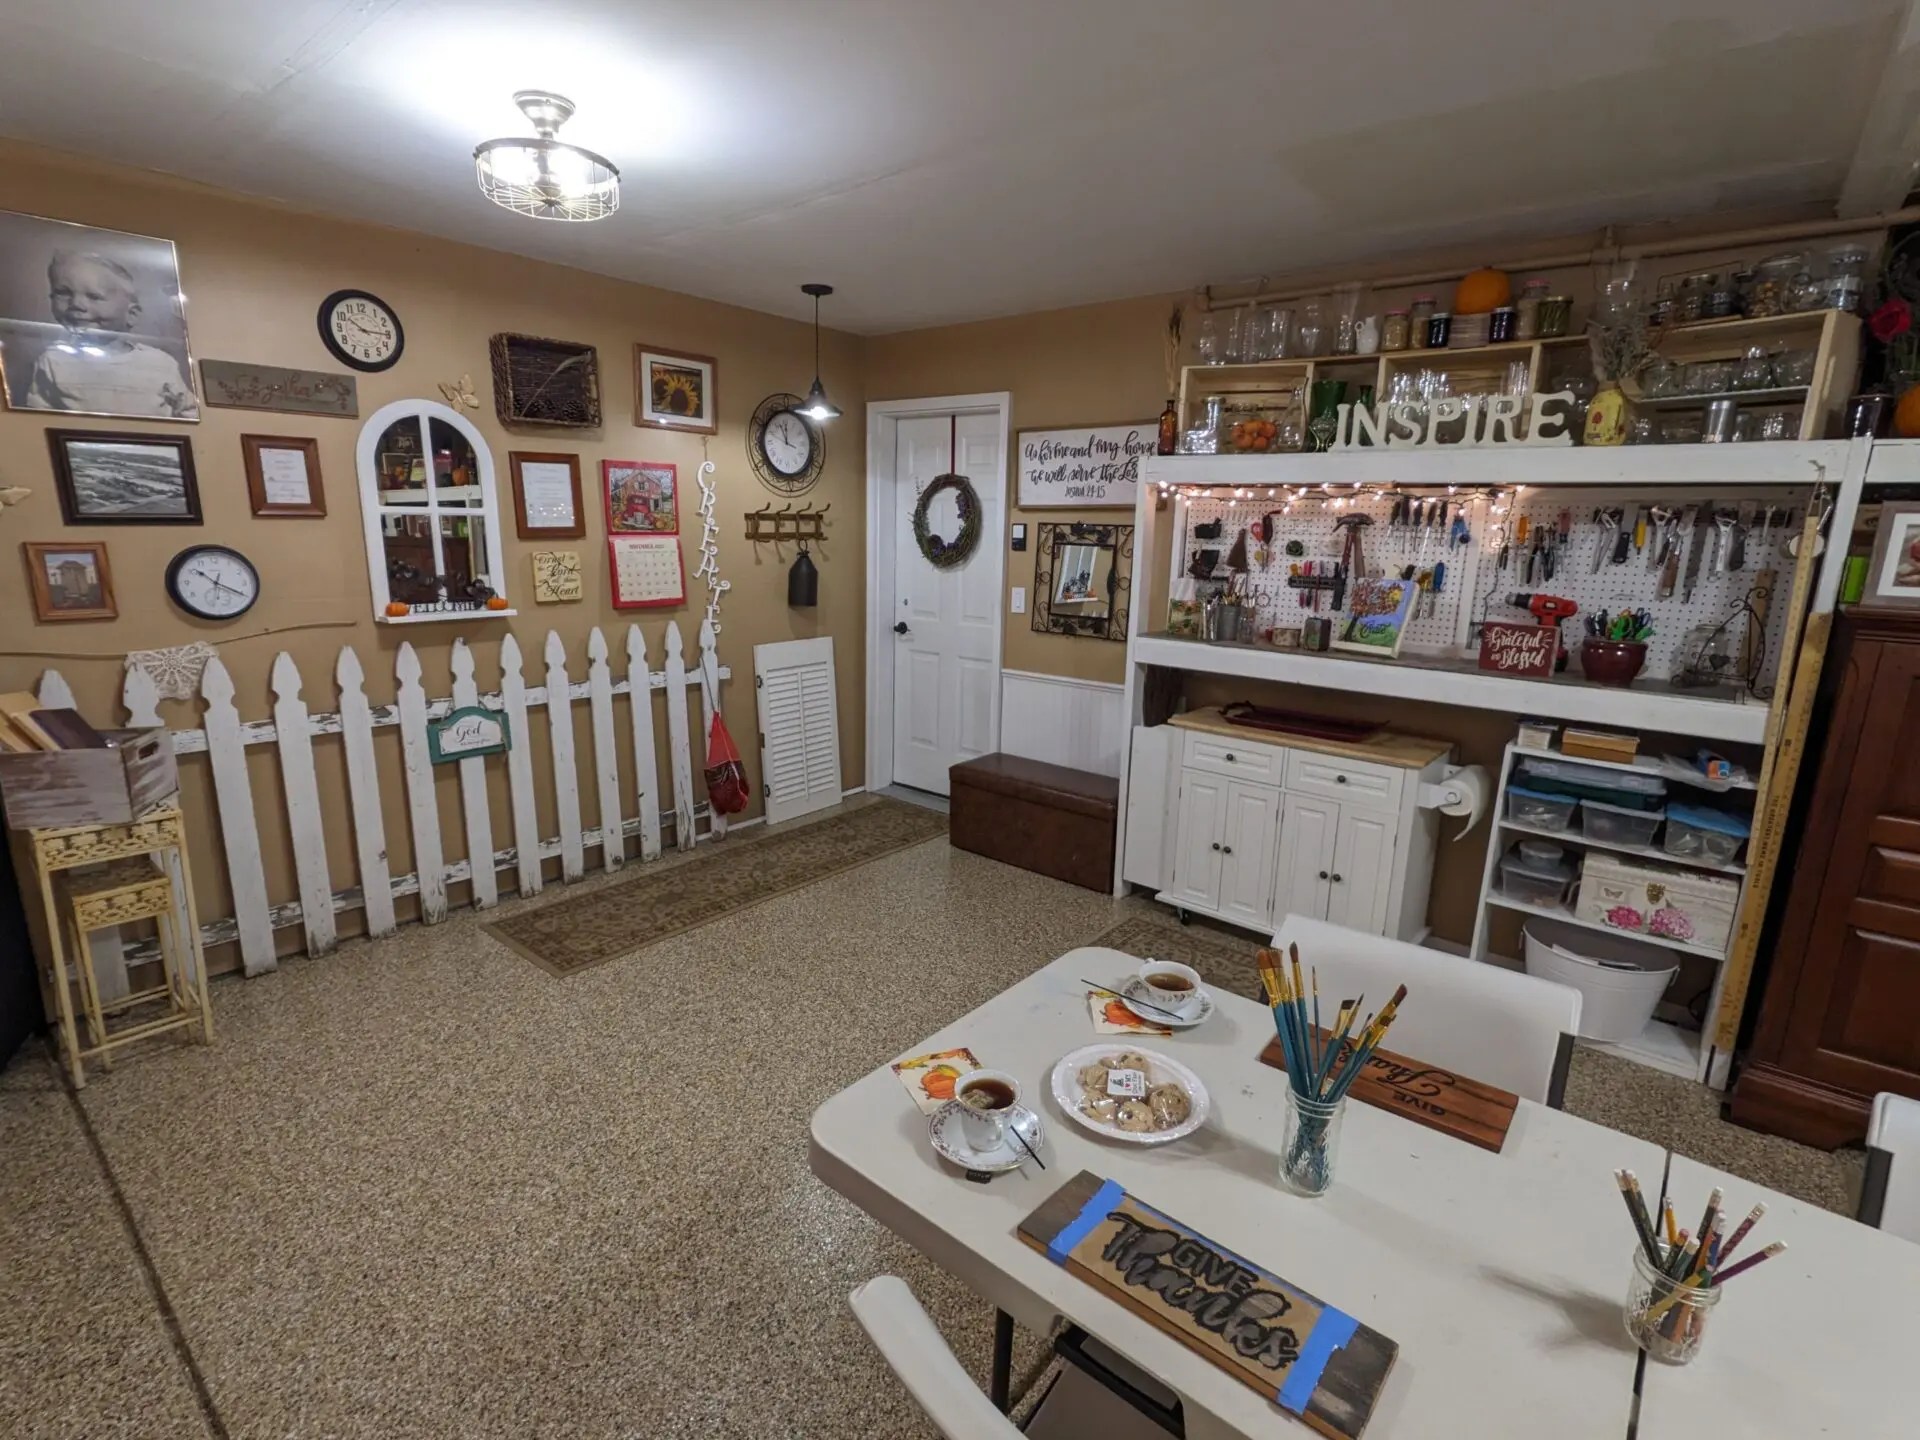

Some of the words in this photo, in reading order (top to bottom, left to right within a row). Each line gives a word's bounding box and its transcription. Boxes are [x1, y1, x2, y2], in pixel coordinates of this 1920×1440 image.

[345, 303, 353, 314] 11
[356, 302, 367, 313] 12
[372, 308, 377, 318] 1
[336, 310, 346, 321] 10
[336, 322, 343, 332] 9
[380, 316, 387, 327] 2
[341, 334, 348, 345] 8
[351, 344, 356, 354] 7
[375, 346, 382, 356] 5
[381, 340, 389, 351] 4
[363, 348, 370, 358] 6
[1328, 390, 1576, 449] INSPIRE
[1069, 434, 1096, 459] and
[1094, 439, 1121, 461] my
[1043, 463, 1068, 483] will
[1118, 455, 1138, 483] Lor
[693, 461, 731, 634] CREATE
[1490, 626, 1544, 652] Grateful
[1498, 648, 1546, 670] Blessed
[1391, 1089, 1446, 1116] GIVE
[1171, 1238, 1260, 1298] GIVE
[1100, 1211, 1300, 1371] Thanks
